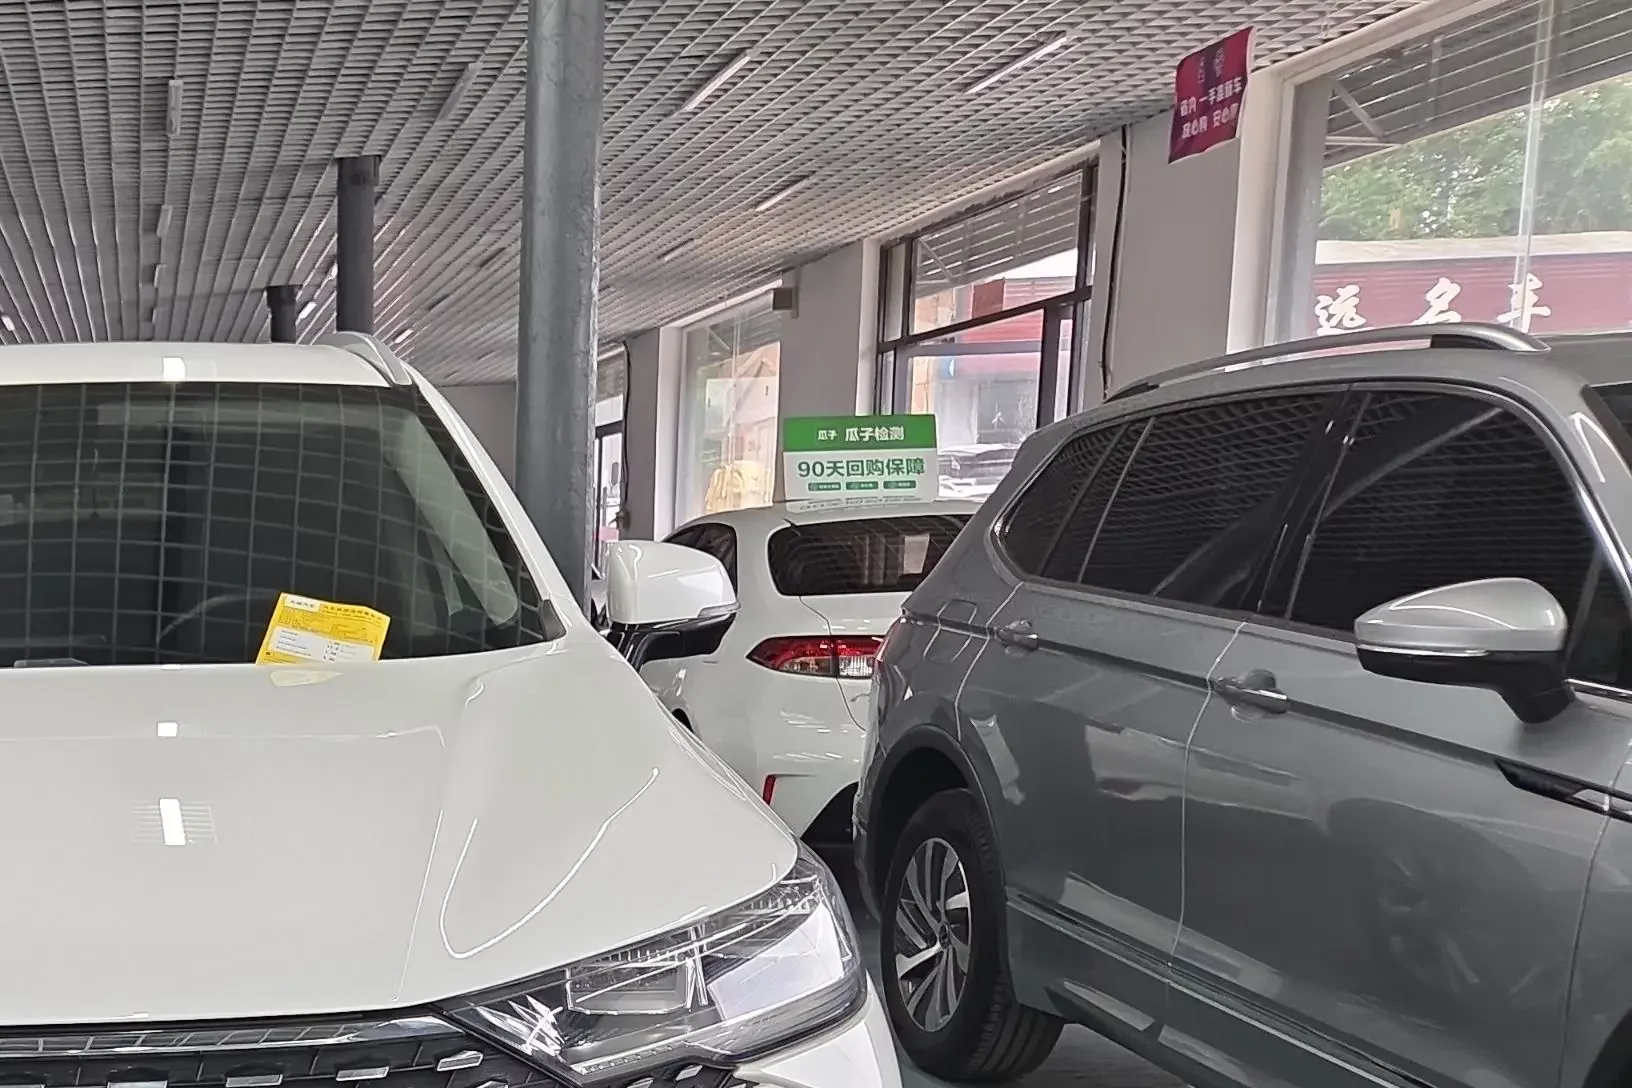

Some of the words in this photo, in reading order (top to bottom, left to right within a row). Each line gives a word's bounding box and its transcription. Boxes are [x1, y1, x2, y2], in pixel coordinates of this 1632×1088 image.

[818, 429, 838, 441] 瓜子
[844, 426, 904, 442] 瓜子检测
[797, 457, 925, 478] 90天回购保障
